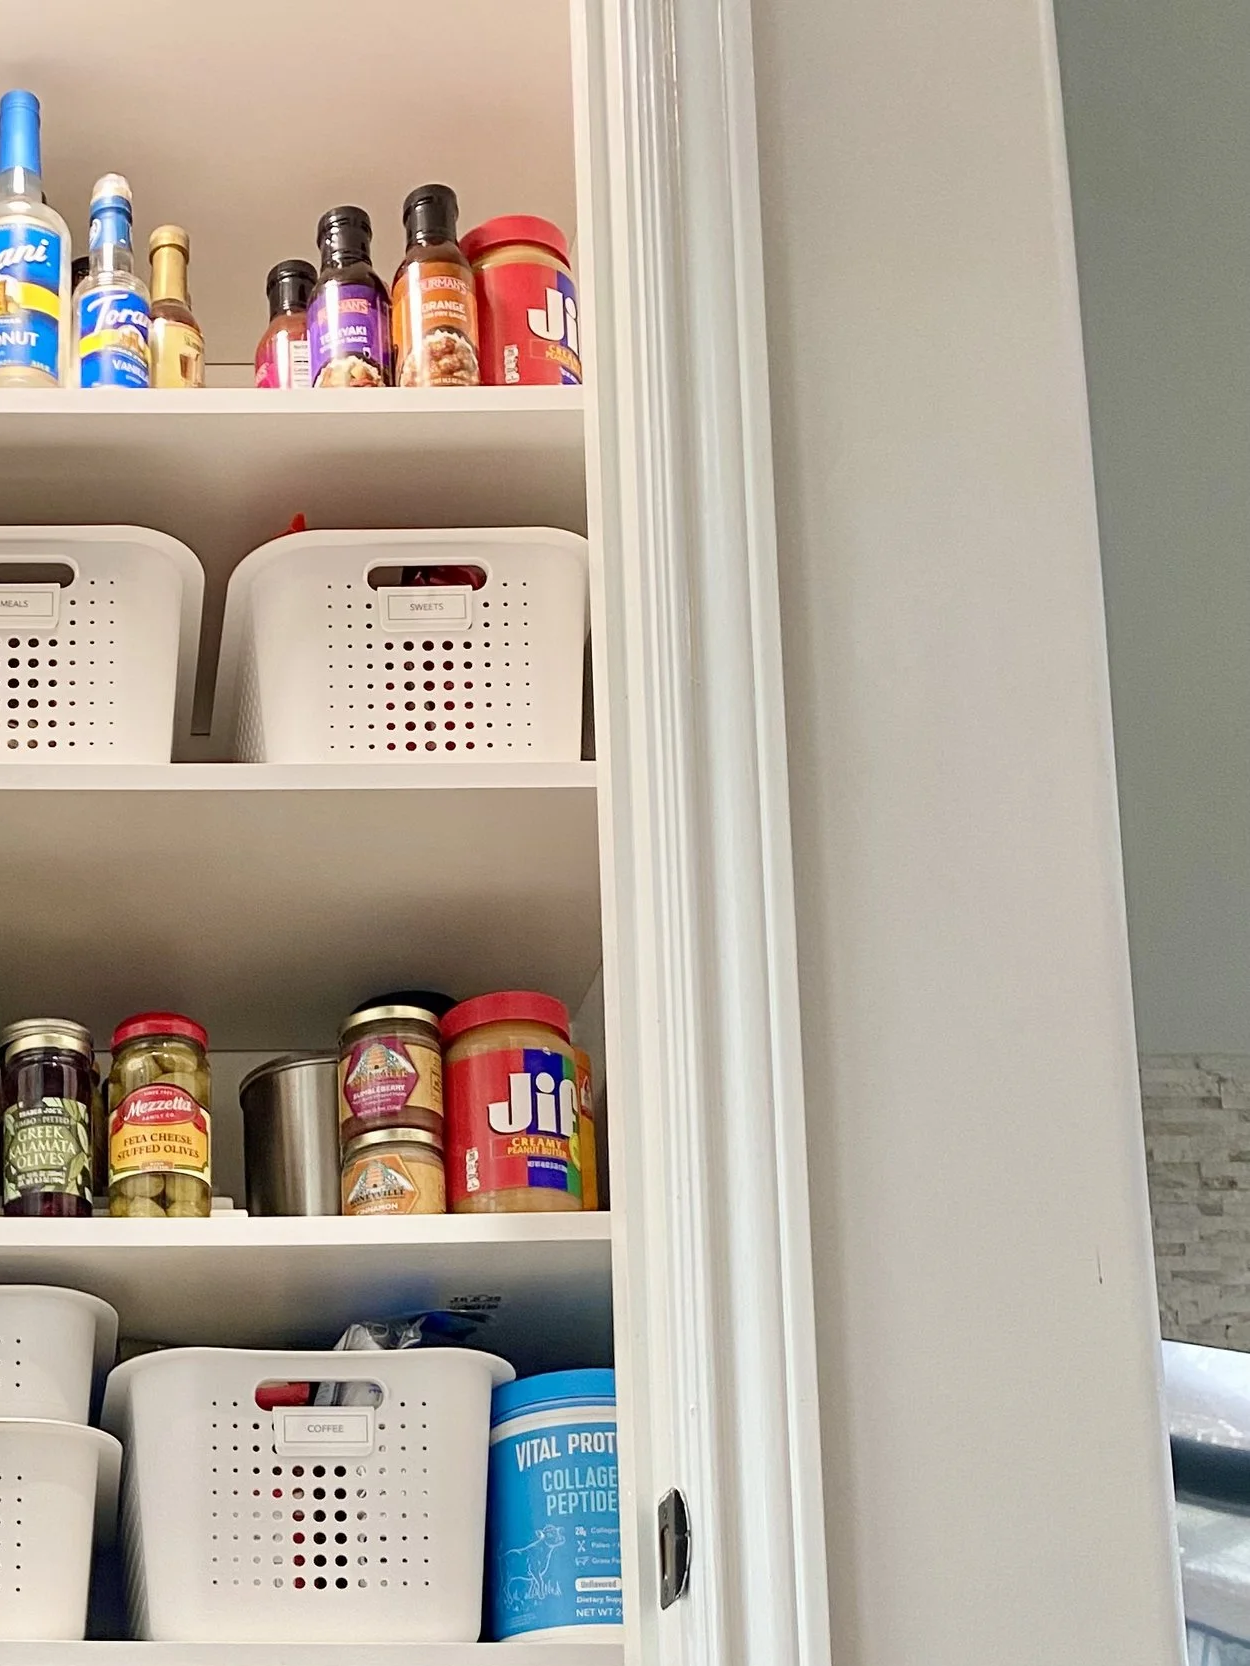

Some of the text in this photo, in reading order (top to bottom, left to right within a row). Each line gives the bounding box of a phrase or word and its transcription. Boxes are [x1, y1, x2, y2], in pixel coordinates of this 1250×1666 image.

[87, 293, 153, 334] Tora
[422, 300, 466, 314] ORANGE
[527, 287, 580, 357] Ji
[0, 600, 29, 608] MEALS
[410, 602, 444, 611] SWEETS
[124, 1096, 191, 1121] Mezzetta
[487, 1071, 579, 1139] Jif
[17, 1125, 64, 1142] GREEK
[123, 1132, 193, 1147] FETA CHEESE
[507, 1146, 539, 1155] PEANUT
[511, 1137, 563, 1149] CREAMY
[16, 1152, 65, 1169] OLIVES
[117, 1144, 200, 1161] STUFFED OLIVES
[307, 1424, 344, 1433] COFFEE
[515, 1431, 616, 1472] VITAL PROT
[542, 1466, 618, 1493] COLLAGE
[546, 1491, 618, 1516] PEPTIDE
[580, 1580, 617, 1589] Unflavored
[576, 1596, 604, 1605] Dietary
[576, 1609, 595, 1617] NET
[598, 1608, 613, 1617] WT
